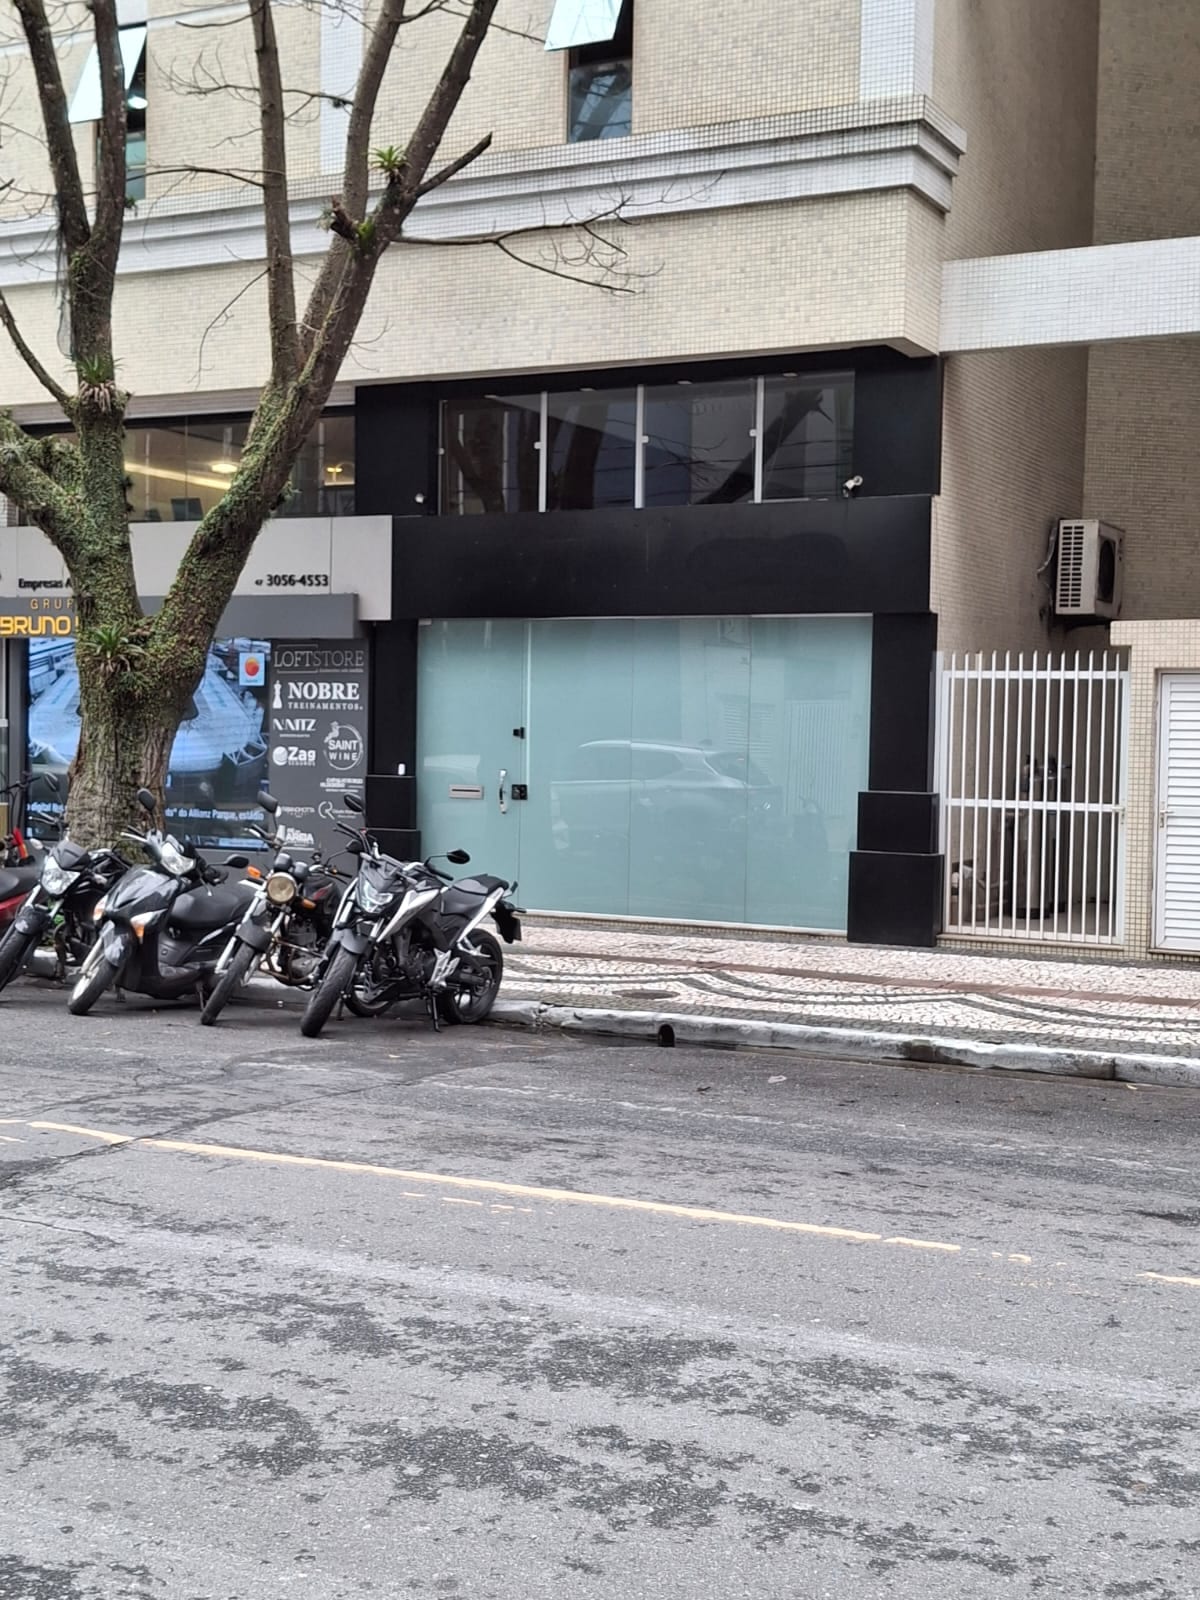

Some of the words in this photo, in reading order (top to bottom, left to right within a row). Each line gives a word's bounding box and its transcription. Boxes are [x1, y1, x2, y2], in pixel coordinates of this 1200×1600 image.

[19, 578, 63, 591] Empresas
[266, 574, 329, 587] 3056-4553
[287, 682, 360, 700] NOBRE
[328, 740, 358, 751] SAINT
[288, 746, 317, 761] Zag
[328, 752, 358, 761] WINE
